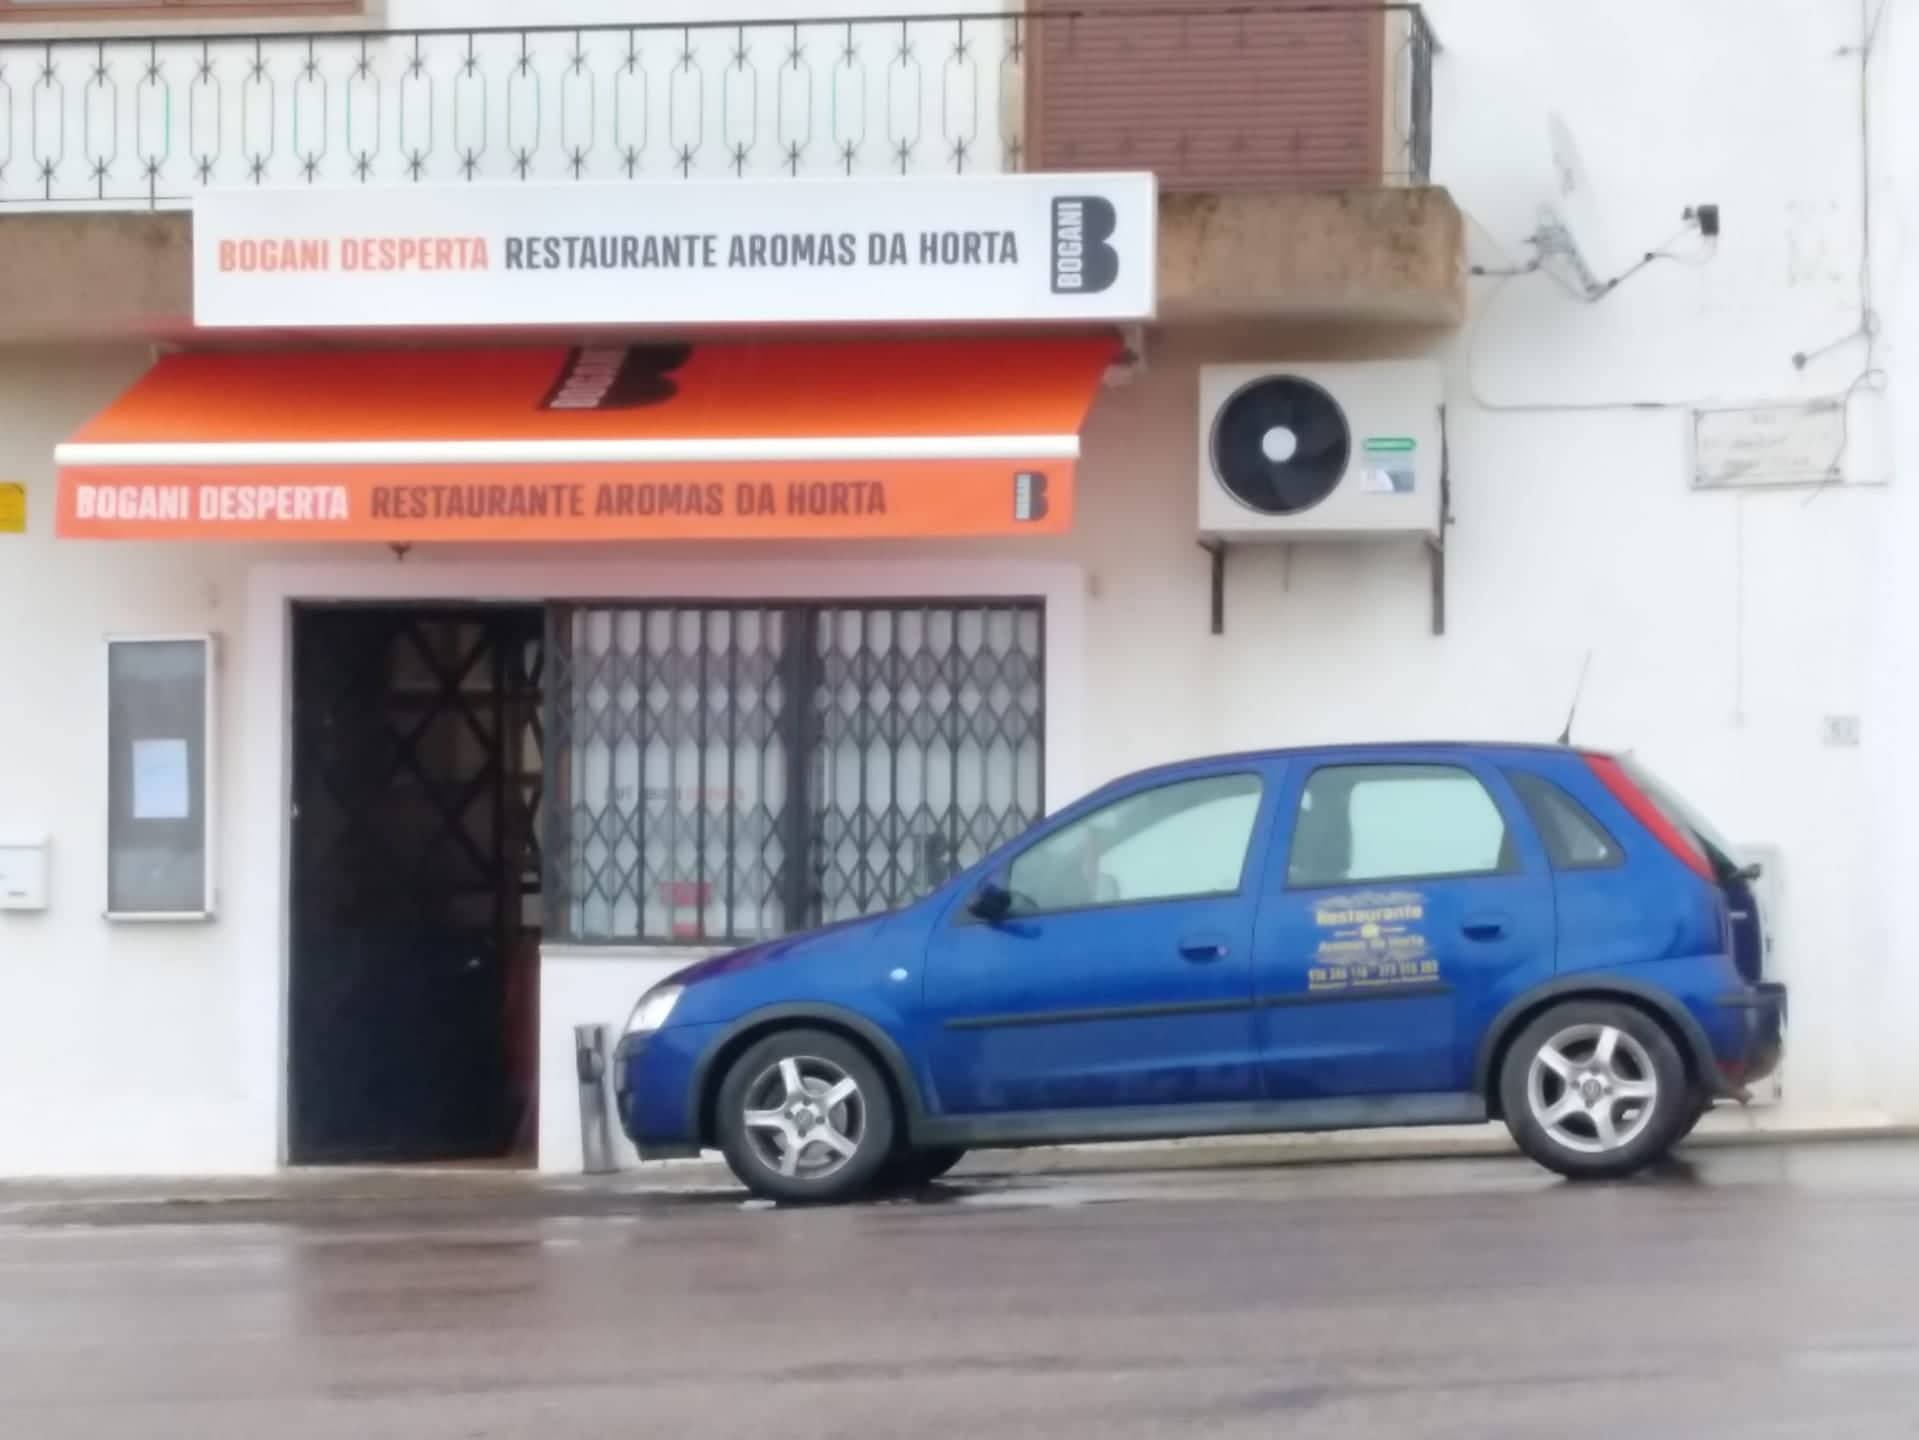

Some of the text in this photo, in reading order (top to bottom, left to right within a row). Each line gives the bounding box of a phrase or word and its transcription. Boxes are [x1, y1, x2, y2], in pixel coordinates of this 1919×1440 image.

[219, 230, 1019, 272] BOGANI DESPERTA RESTAURANTE AROMAS DA HORTA
[1055, 201, 1083, 289] BOGANI
[76, 481, 886, 521] BOGANI DESPERTA RESTAURANTE AROMAS DA HORTA
